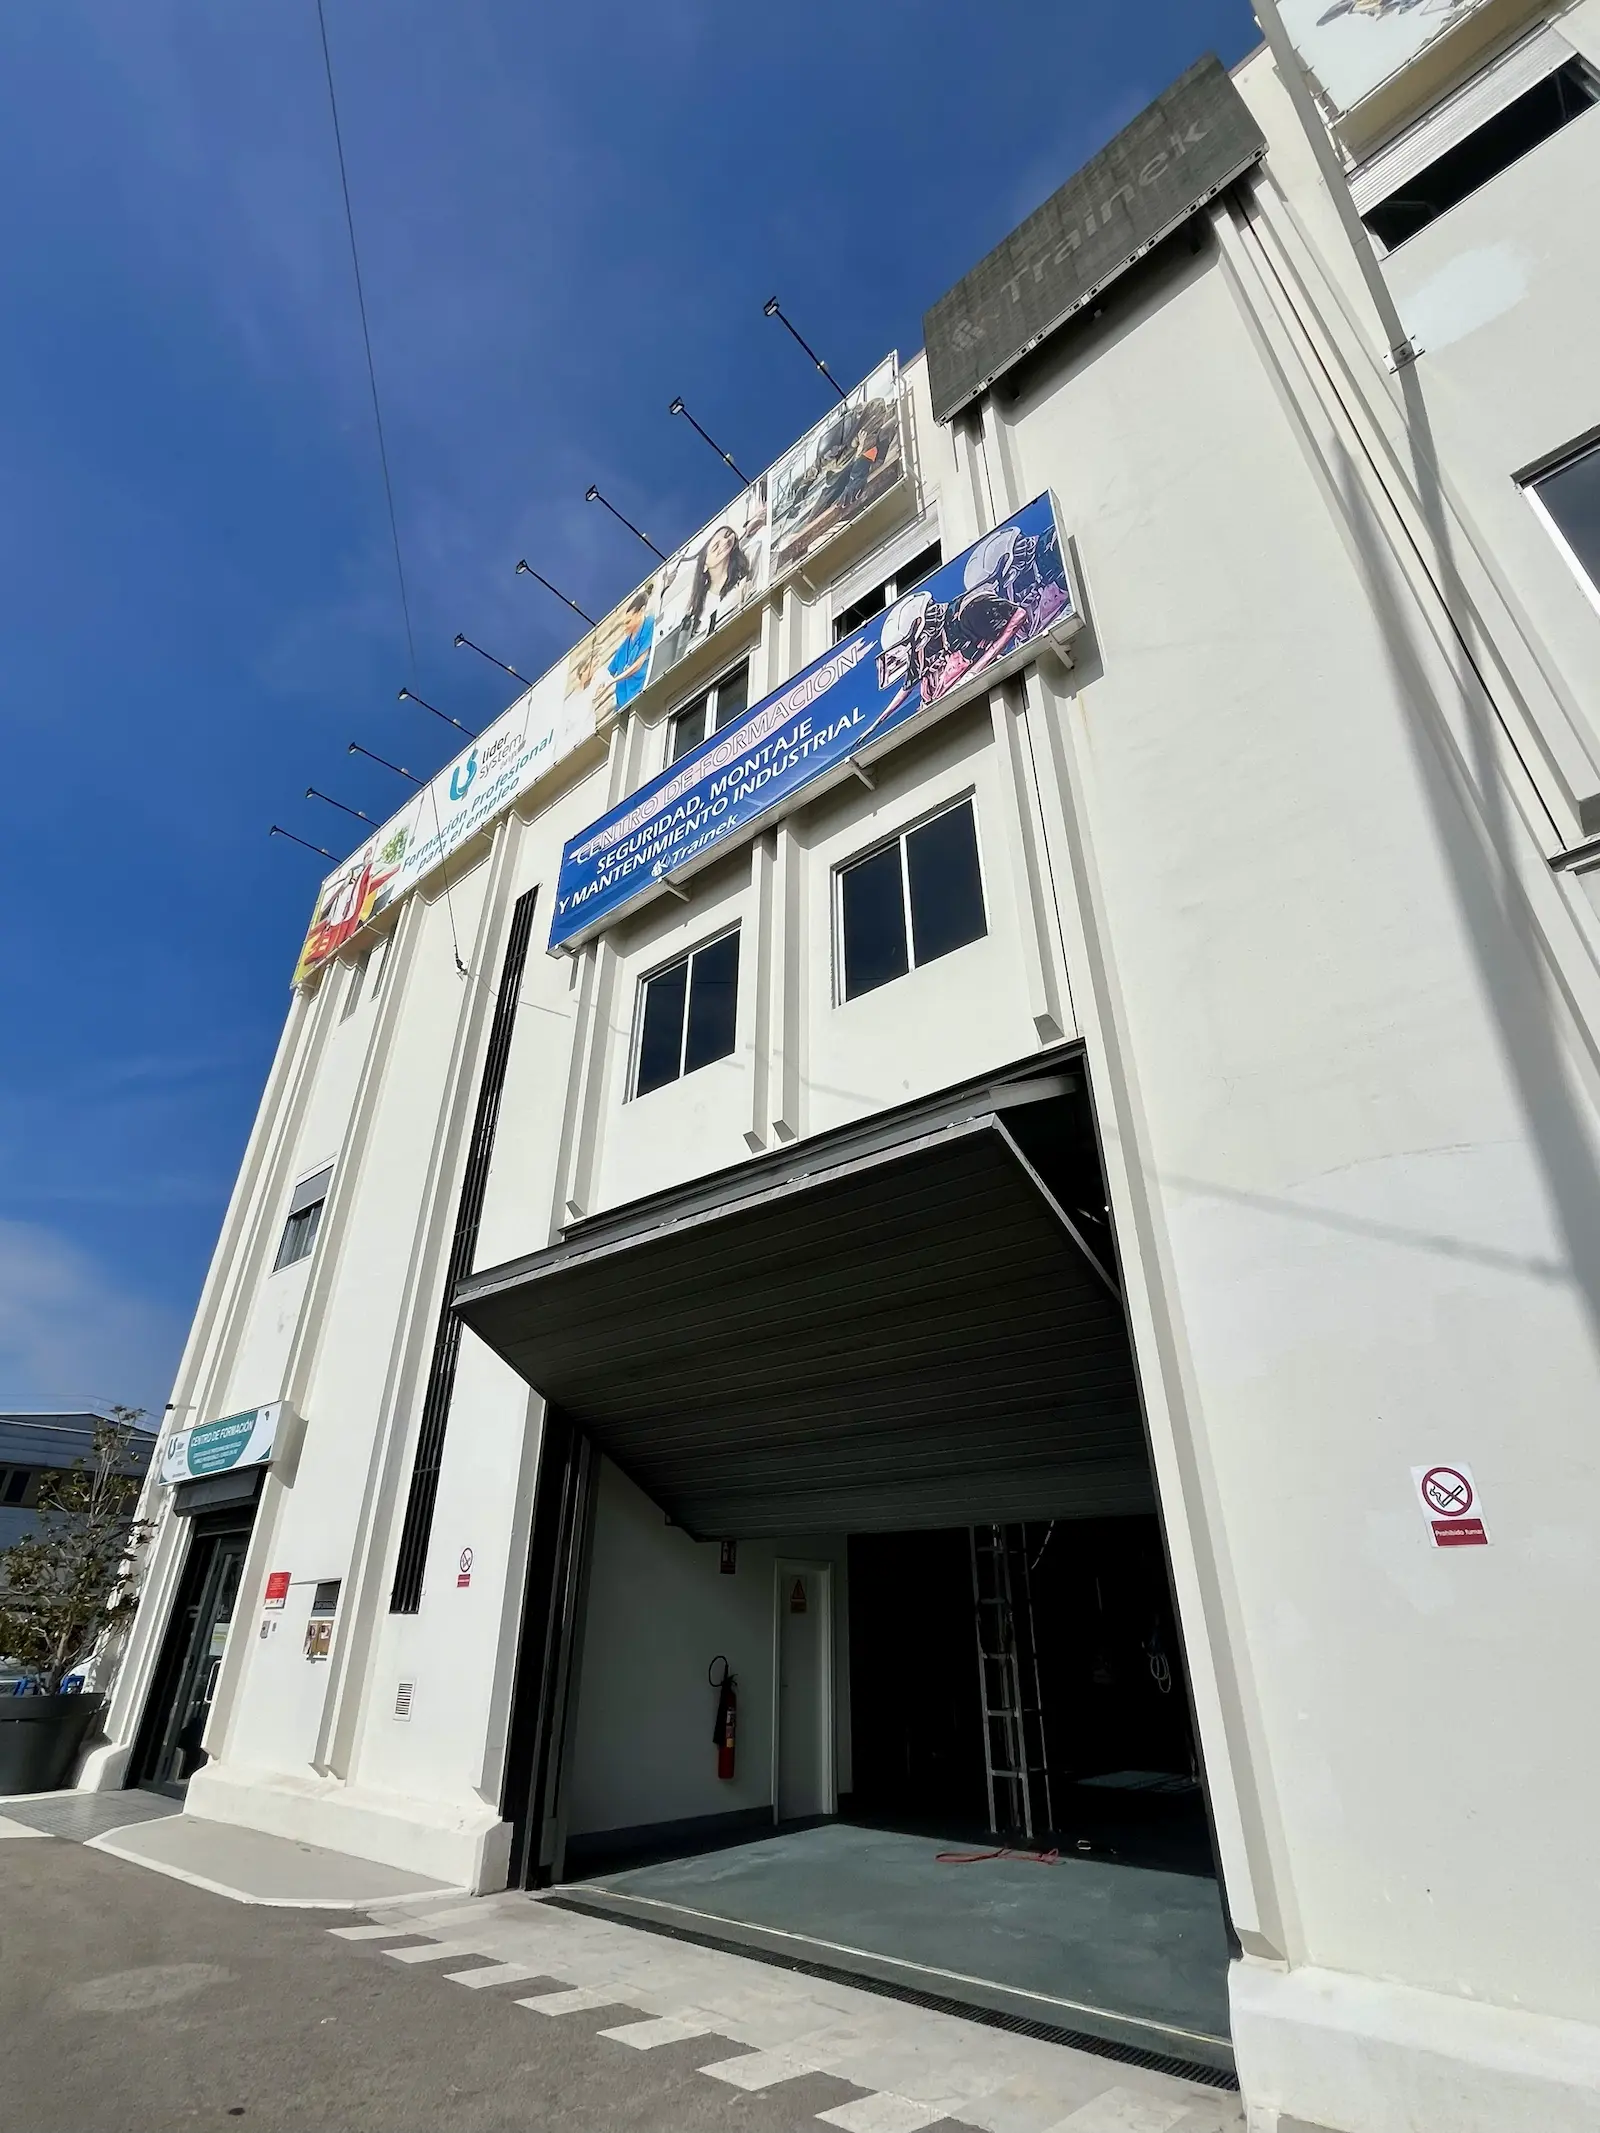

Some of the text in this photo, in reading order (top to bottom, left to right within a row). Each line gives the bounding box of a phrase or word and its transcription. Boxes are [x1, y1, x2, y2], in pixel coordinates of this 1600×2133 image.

[480, 734, 521, 779] system
[576, 645, 858, 864] CENTRO DE FORMACIÓN
[417, 777, 519, 874] para el empleo
[557, 707, 866, 915] Y MANTENIMIENTO INDUSTRIAL
[597, 717, 813, 874] SEGURIDAD, MONTAJE
[402, 809, 467, 872] Formación
[672, 814, 738, 864] Trainek
[190, 1431, 211, 1448] CENTRO
[219, 1419, 254, 1440] FORMACIÓN
